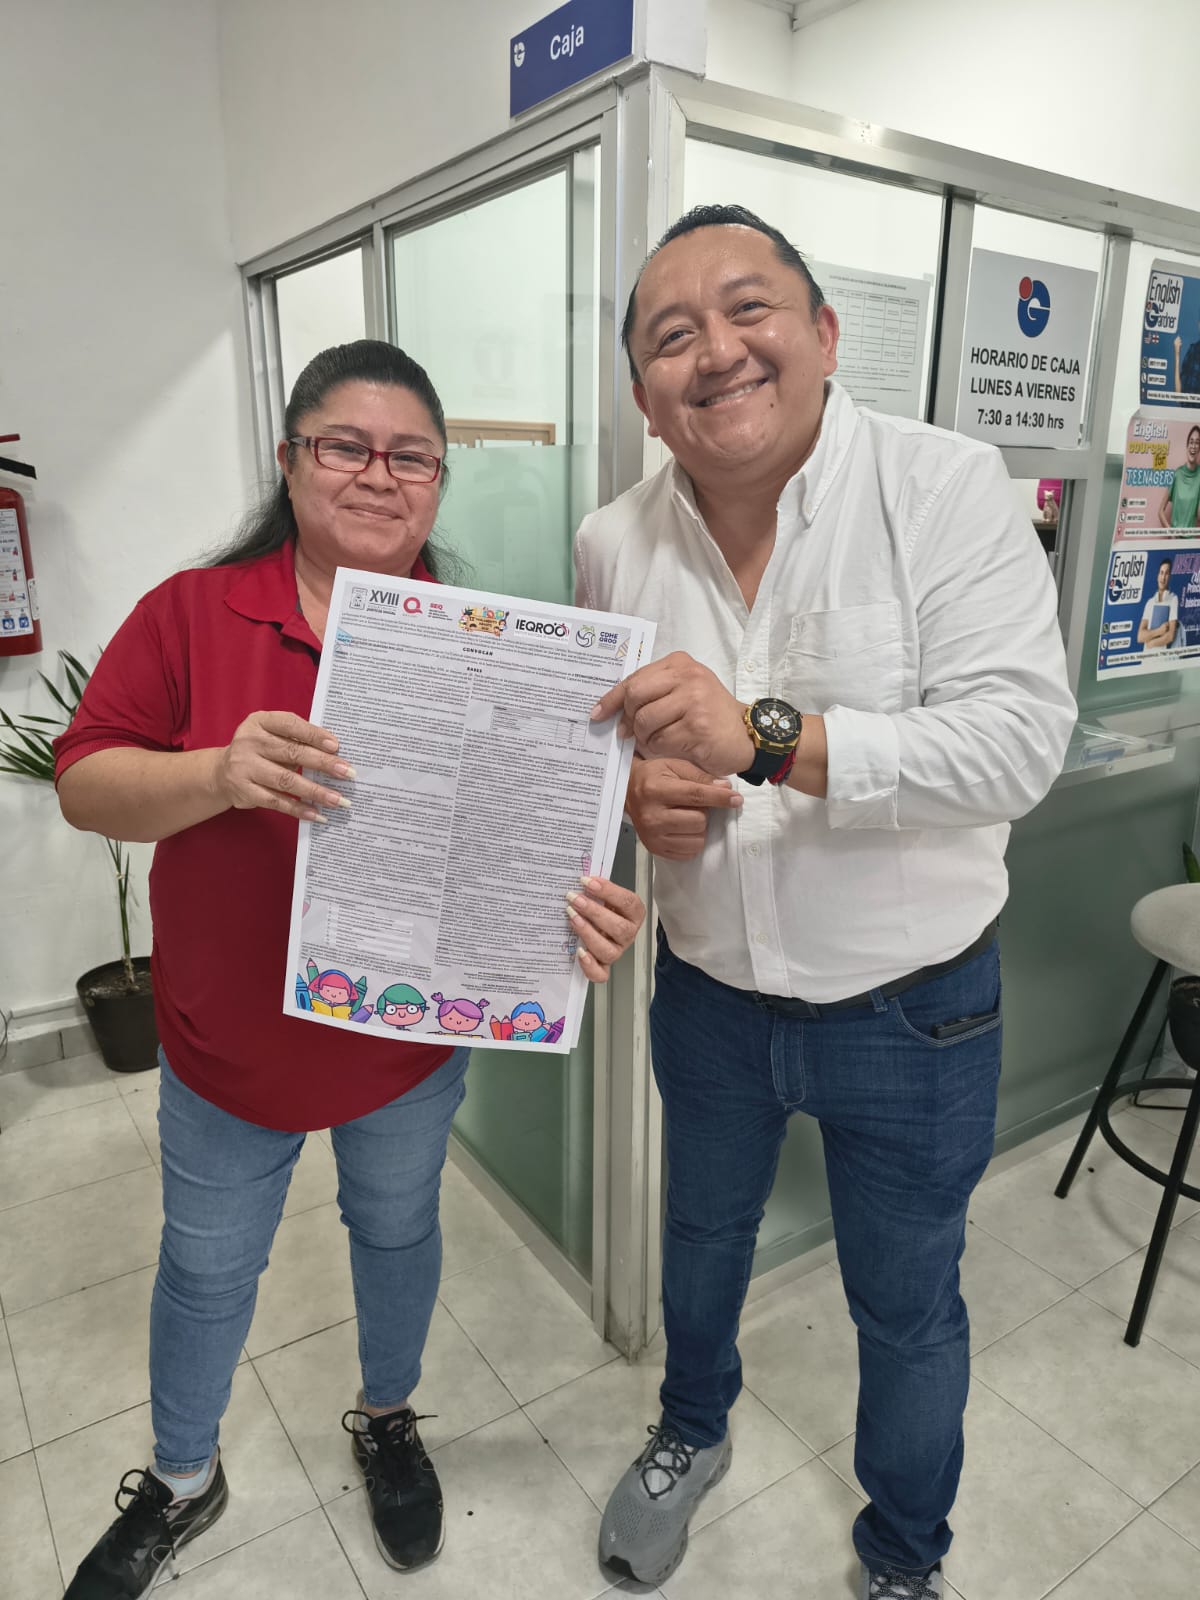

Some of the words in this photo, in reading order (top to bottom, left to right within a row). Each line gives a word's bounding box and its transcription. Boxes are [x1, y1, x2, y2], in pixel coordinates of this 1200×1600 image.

[550, 24, 584, 60] Caja
[1149, 276, 1181, 312] English
[970, 347, 1028, 369] HORARIO
[1031, 354, 1048, 371] DE
[1050, 357, 1080, 375] CAJA
[970, 377, 1012, 397] LUNES
[1015, 382, 1024, 397] A
[1026, 382, 1076, 402] VIERNES
[977, 408, 1002, 426] 7:30
[1005, 415, 1012, 426] a
[1015, 411, 1045, 428] 14:30
[1047, 413, 1064, 430] hrs
[1133, 421, 1168, 441] English
[1126, 469, 1174, 485] TEENAGERS
[1112, 555, 1145, 586] English
[369, 589, 400, 606] XVIII
[600, 631, 619, 640] CDHE
